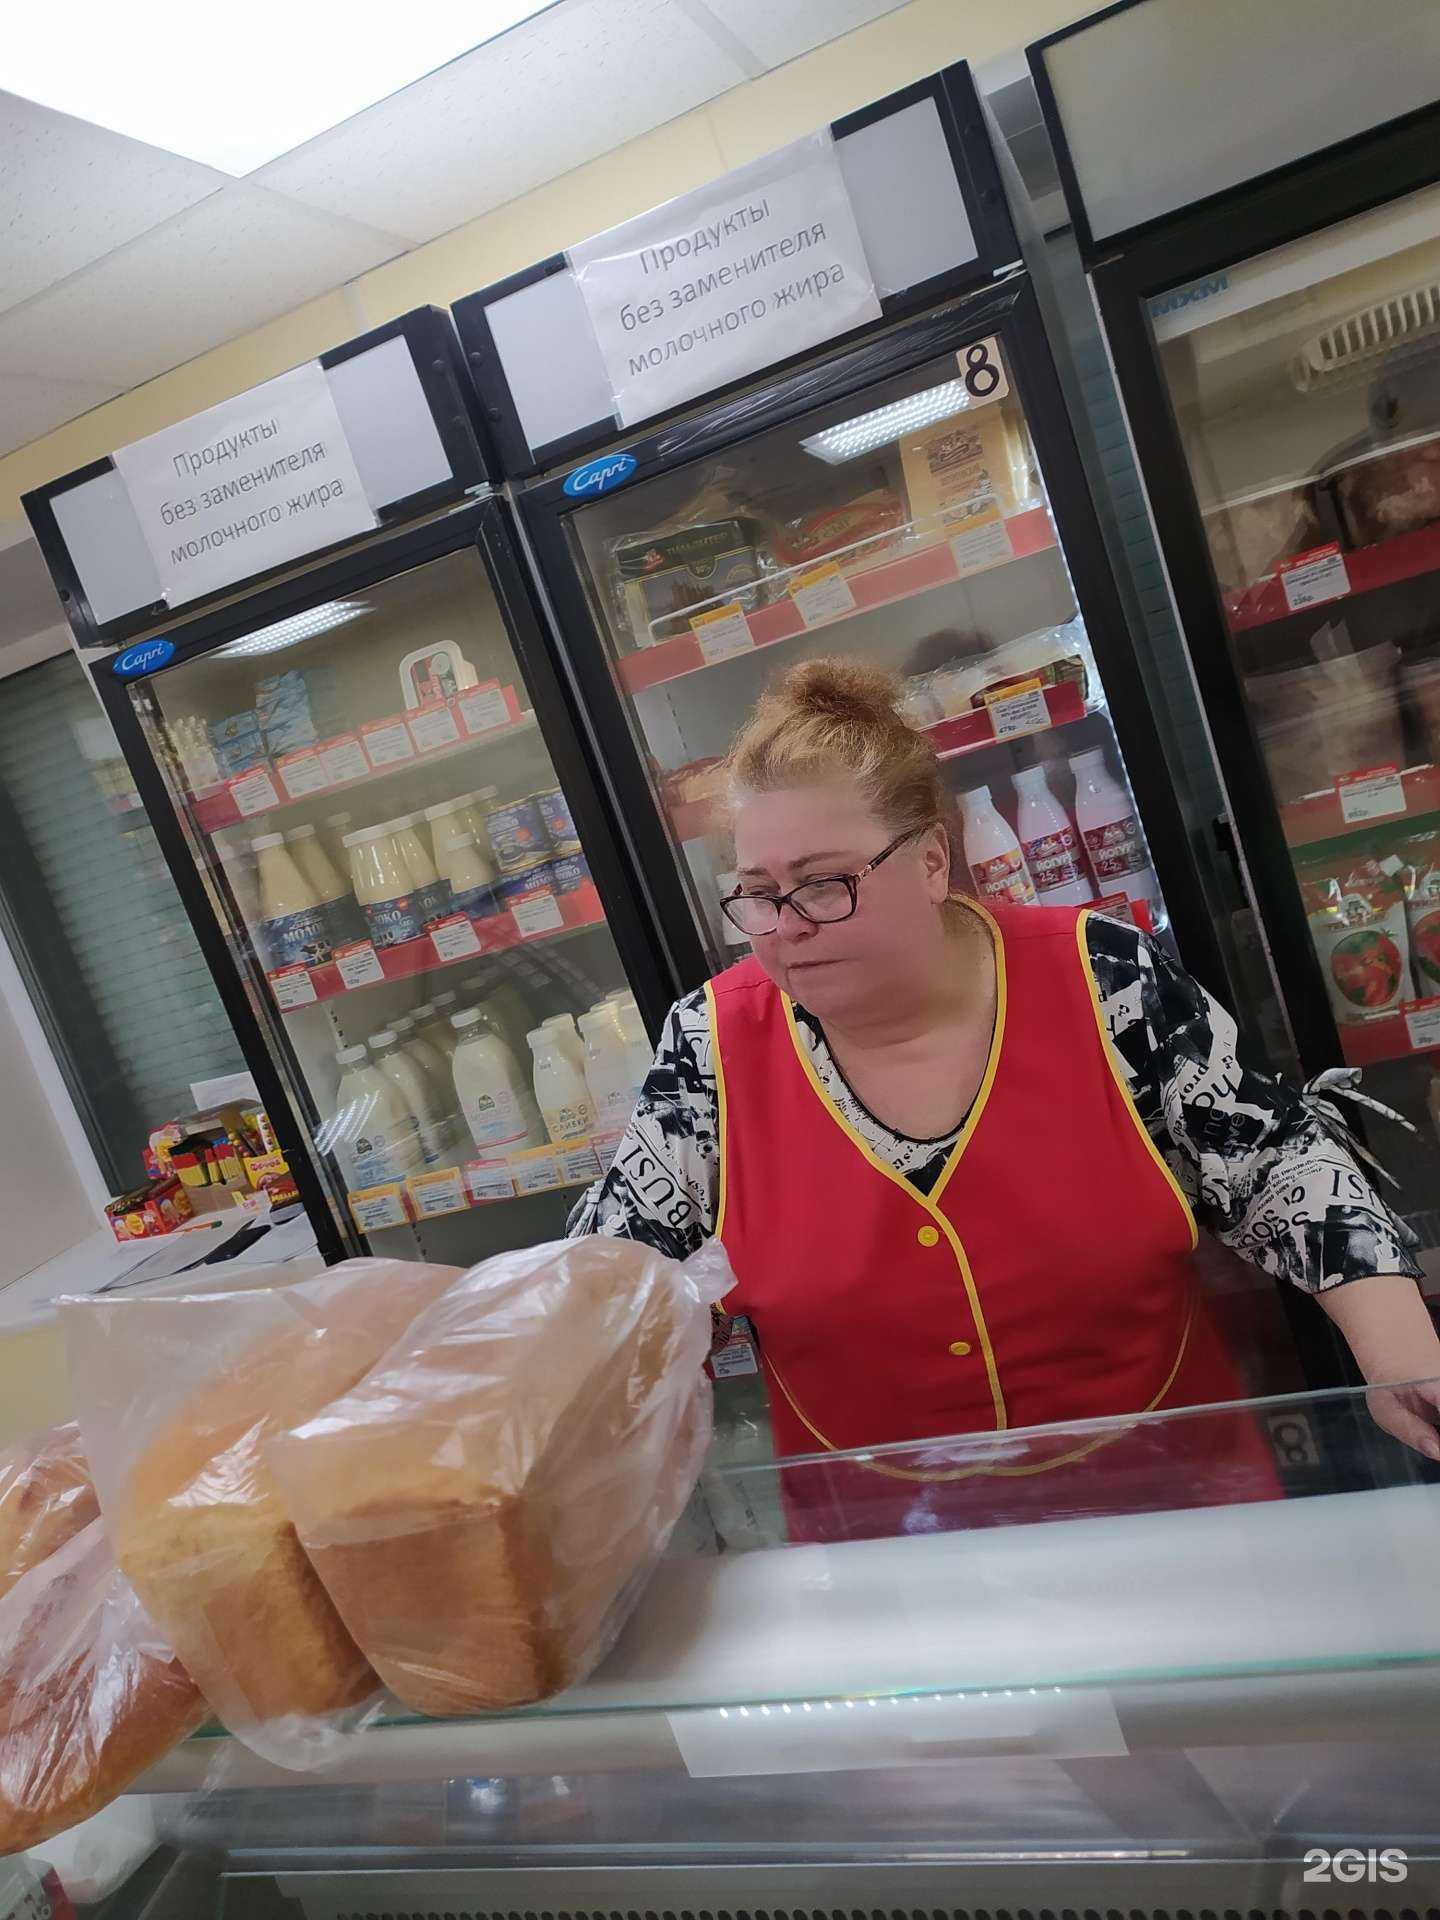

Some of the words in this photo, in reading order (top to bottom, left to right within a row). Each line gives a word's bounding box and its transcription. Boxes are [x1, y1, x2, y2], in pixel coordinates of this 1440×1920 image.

[639, 198, 771, 275] Продукты
[620, 300, 664, 331] без
[672, 222, 828, 311] заменителя
[628, 300, 767, 376] молочного
[773, 259, 845, 310] жира
[964, 343, 1001, 397] 8
[160, 496, 197, 526] без
[201, 441, 326, 510] заменителя
[172, 419, 278, 479] Продукты
[573, 458, 629, 491] Capri
[170, 503, 282, 565] молочного
[286, 477, 345, 518] жира
[121, 643, 165, 672] Capri
